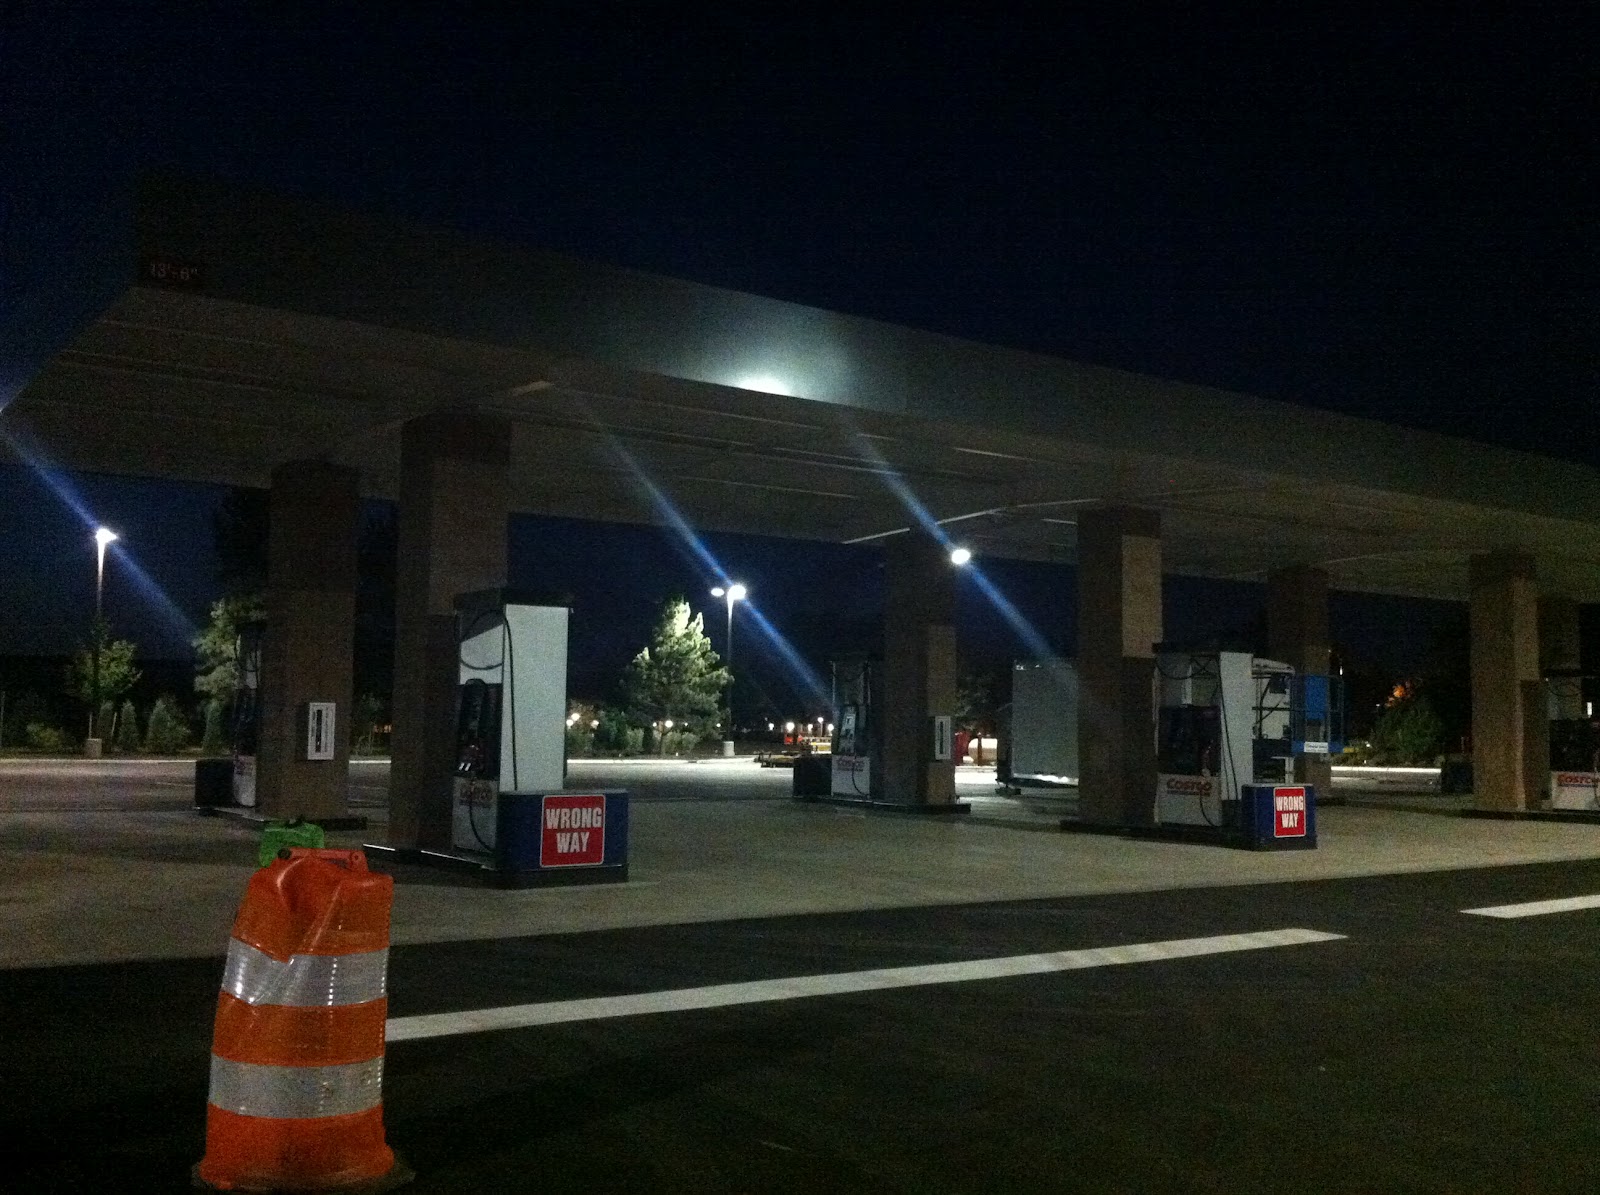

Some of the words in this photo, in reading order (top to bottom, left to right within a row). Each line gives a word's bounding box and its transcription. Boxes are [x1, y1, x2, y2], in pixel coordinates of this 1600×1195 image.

[1276, 795, 1304, 811] WRONG
[545, 806, 602, 830] WRONG
[1281, 813, 1299, 828] WAY
[556, 831, 590, 854] WAY
